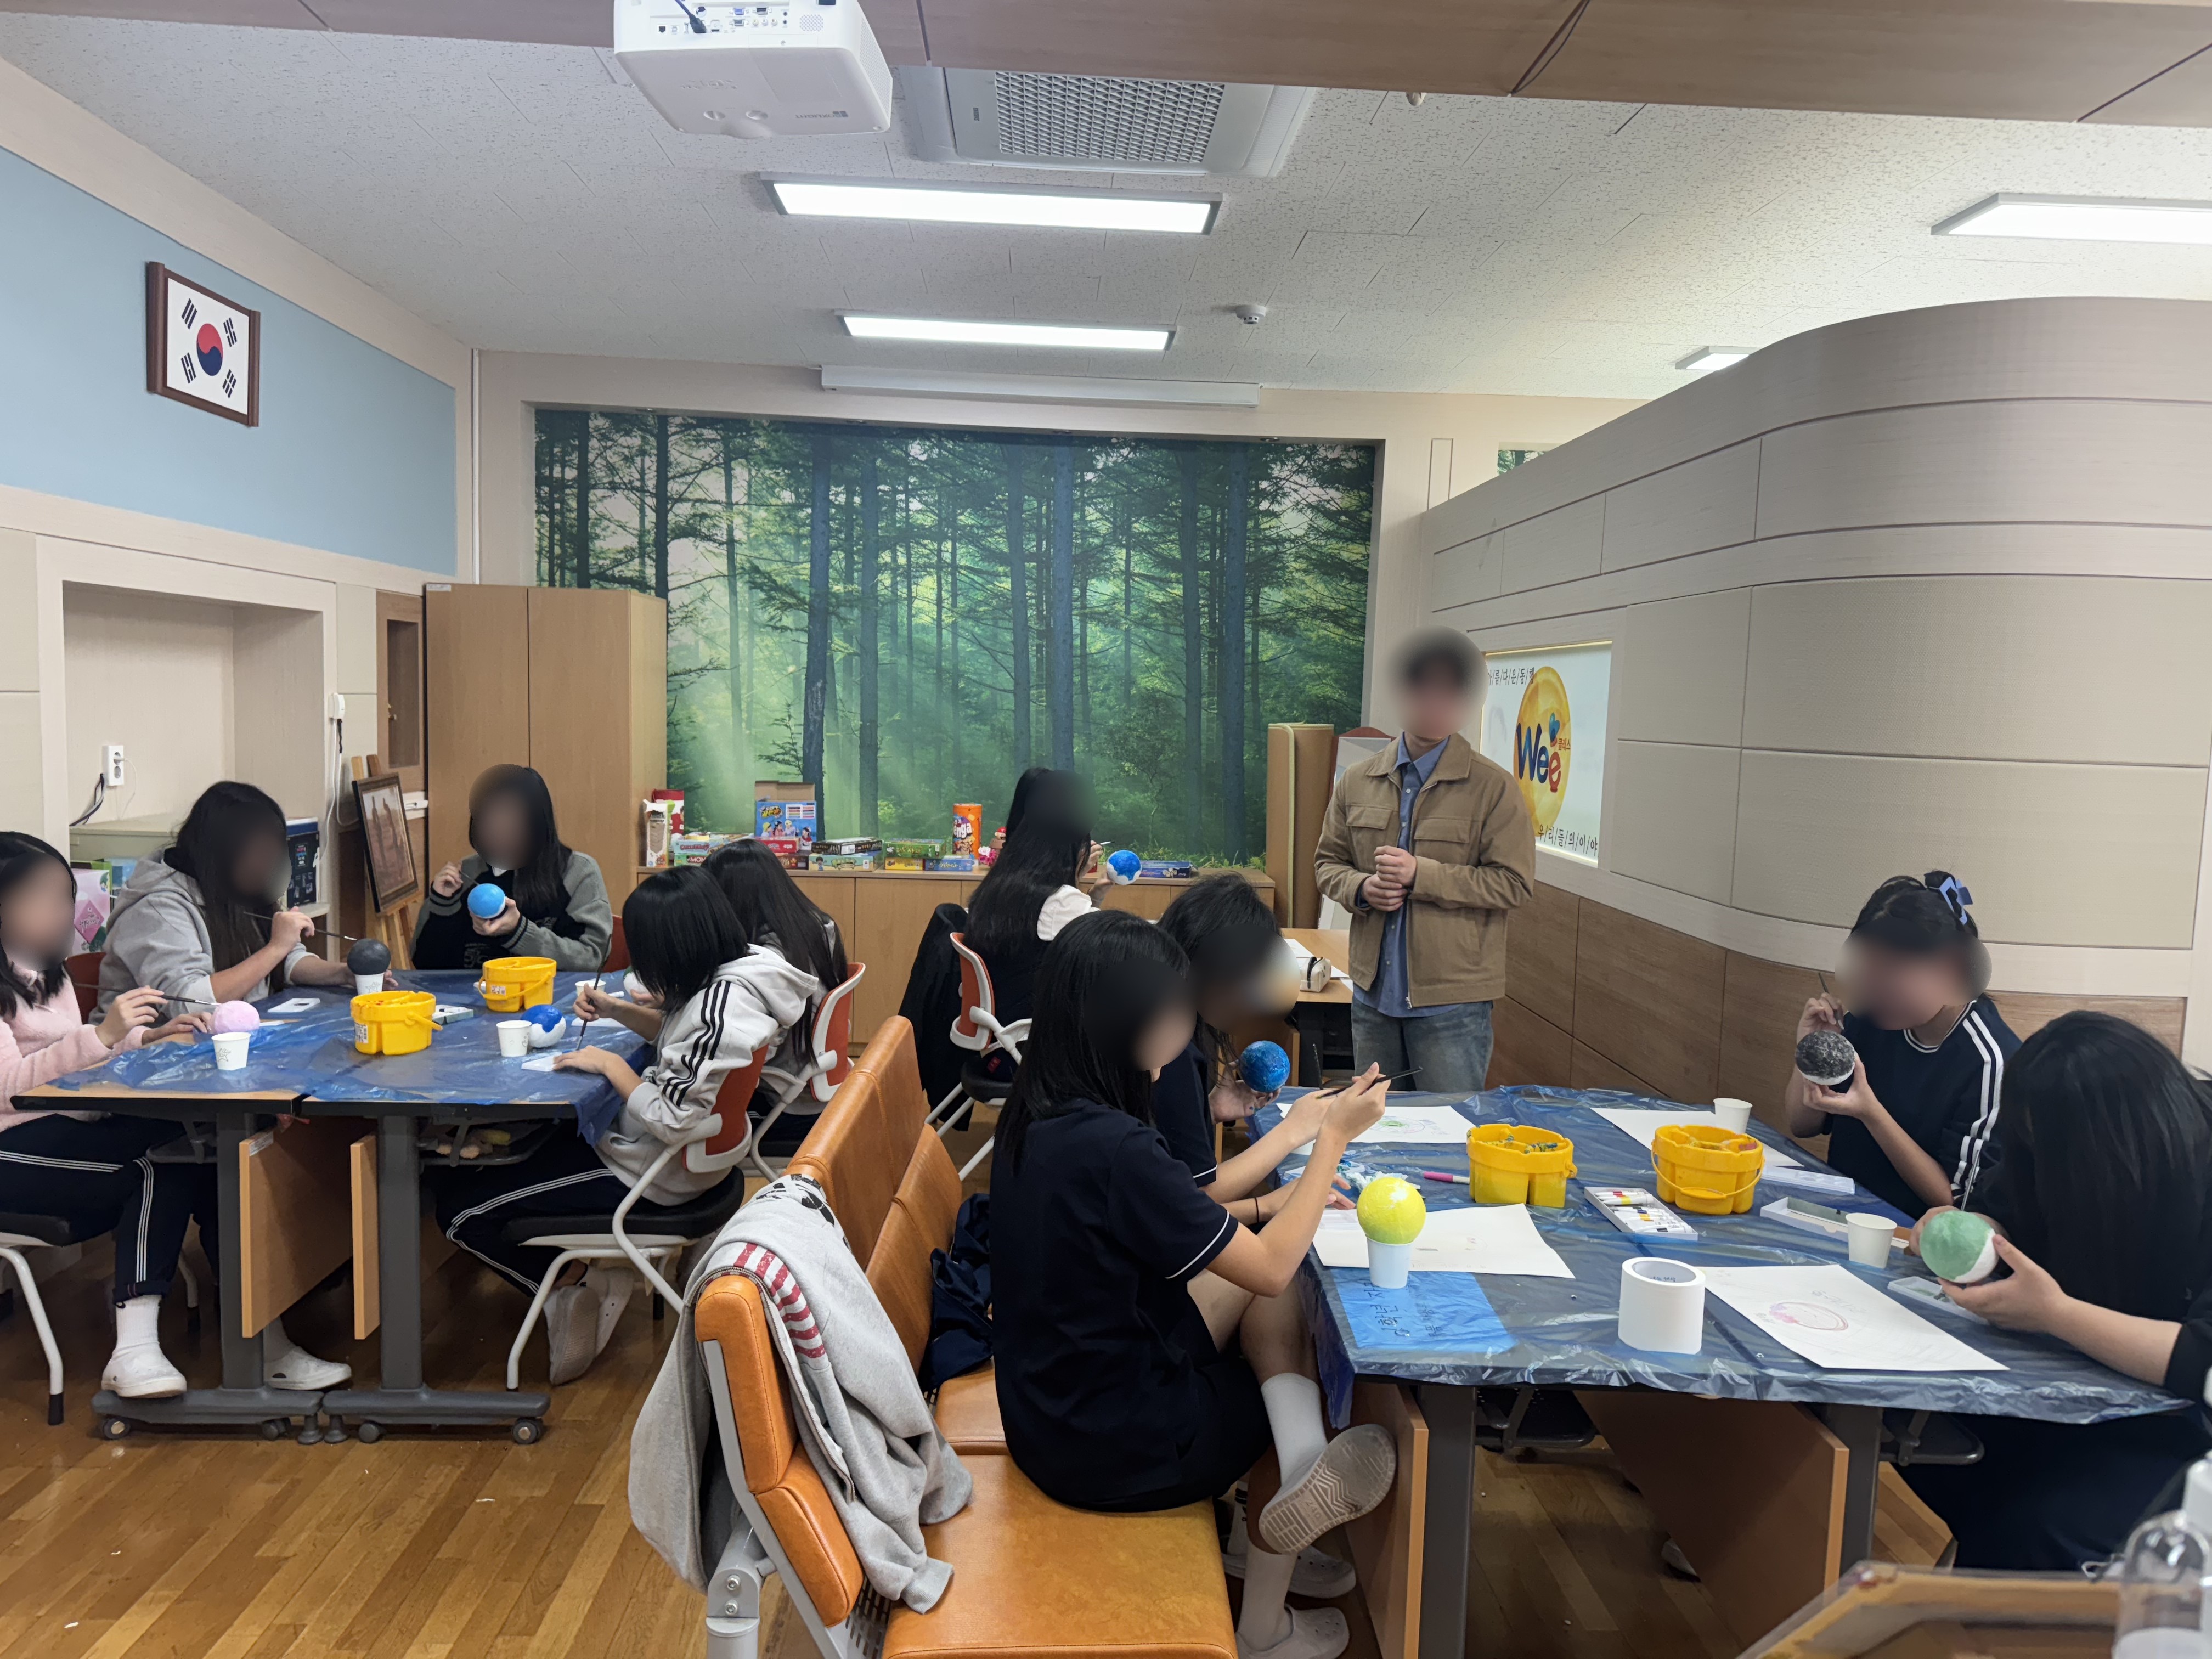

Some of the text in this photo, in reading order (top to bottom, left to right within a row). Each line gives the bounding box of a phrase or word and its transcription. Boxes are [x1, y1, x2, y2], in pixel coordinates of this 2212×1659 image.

[1558, 738, 1571, 752] 클래스
[1516, 723, 1561, 793] Wee
[953, 822, 972, 839] enga
